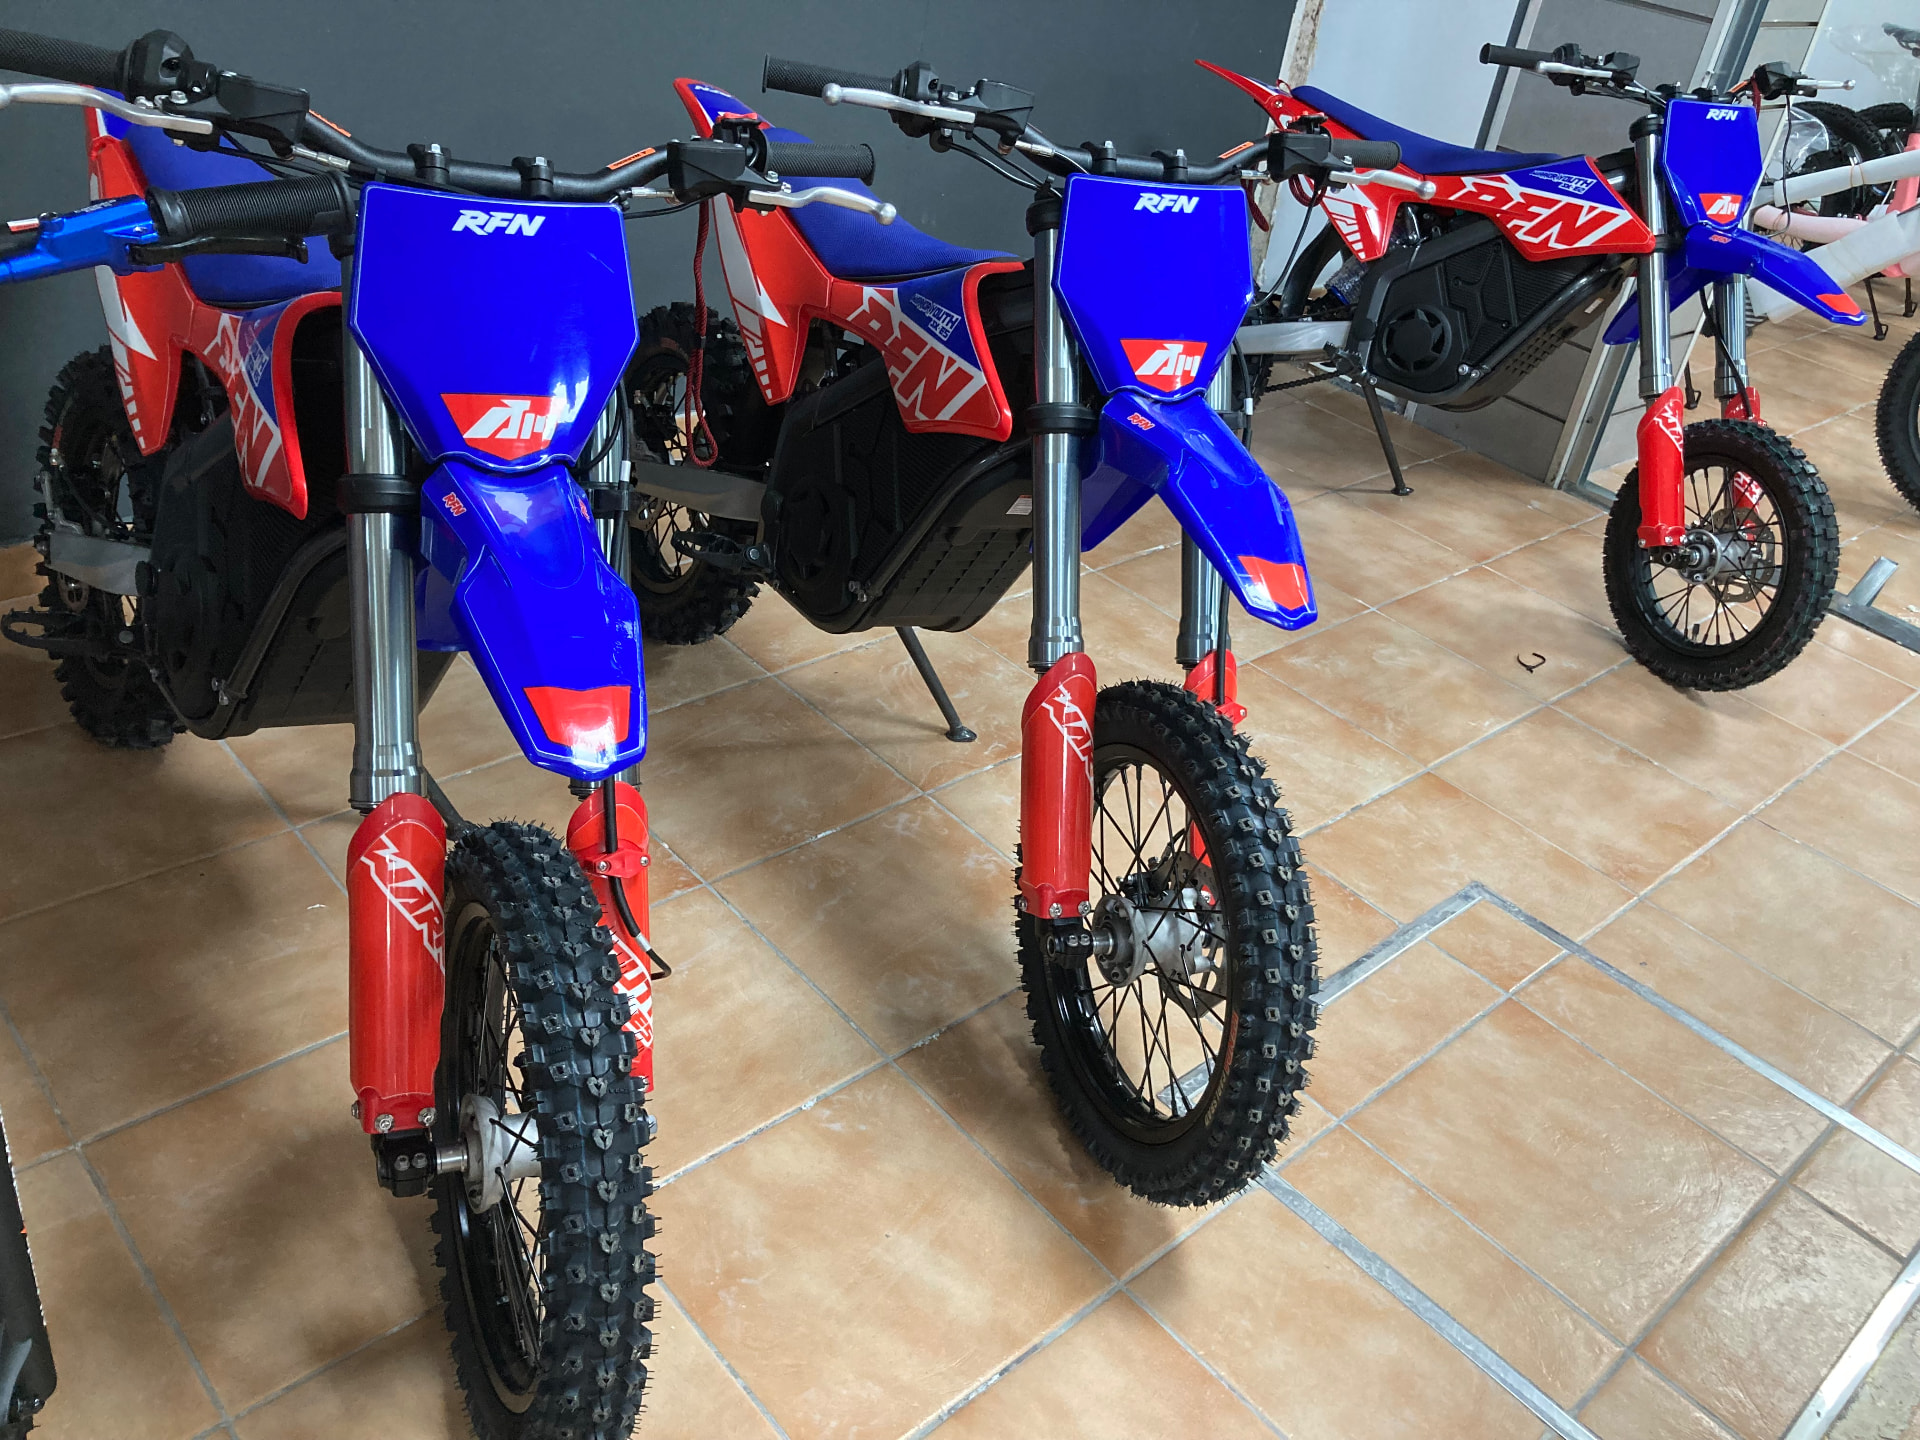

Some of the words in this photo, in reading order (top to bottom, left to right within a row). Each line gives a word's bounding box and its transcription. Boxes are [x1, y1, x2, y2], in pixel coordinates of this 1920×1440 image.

[1706, 108, 1739, 121] RFN
[1133, 192, 1200, 214] RFN
[1449, 176, 1633, 249] RFN
[451, 209, 546, 237] RFN
[848, 287, 986, 421] RFN
[1127, 412, 1156, 431] RFN
[442, 492, 467, 517] RFN
